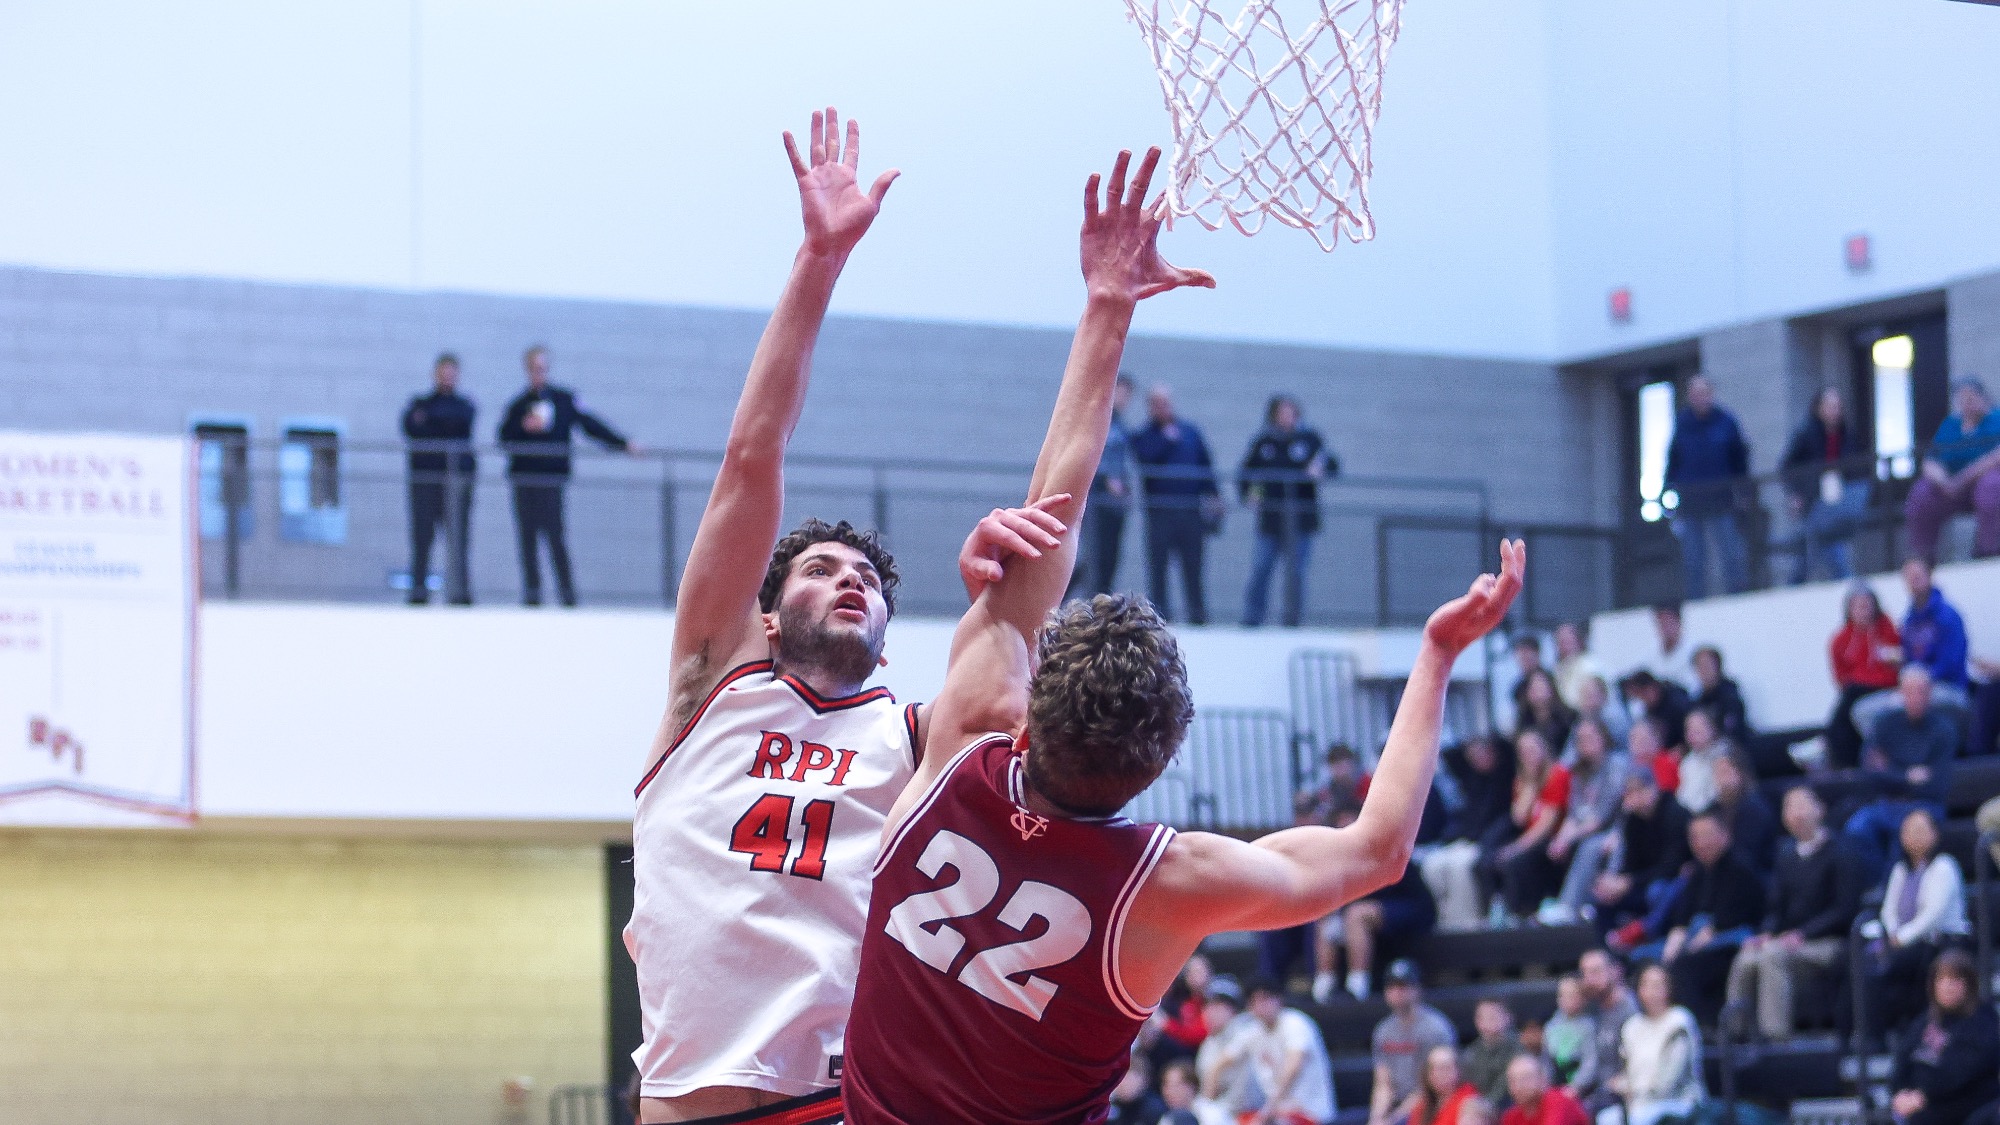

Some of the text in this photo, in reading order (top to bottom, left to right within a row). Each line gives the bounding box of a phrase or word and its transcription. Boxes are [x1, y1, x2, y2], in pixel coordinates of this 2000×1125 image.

[746, 730, 859, 786] RPI
[728, 793, 835, 881] 41
[883, 829, 1092, 1022] 22
